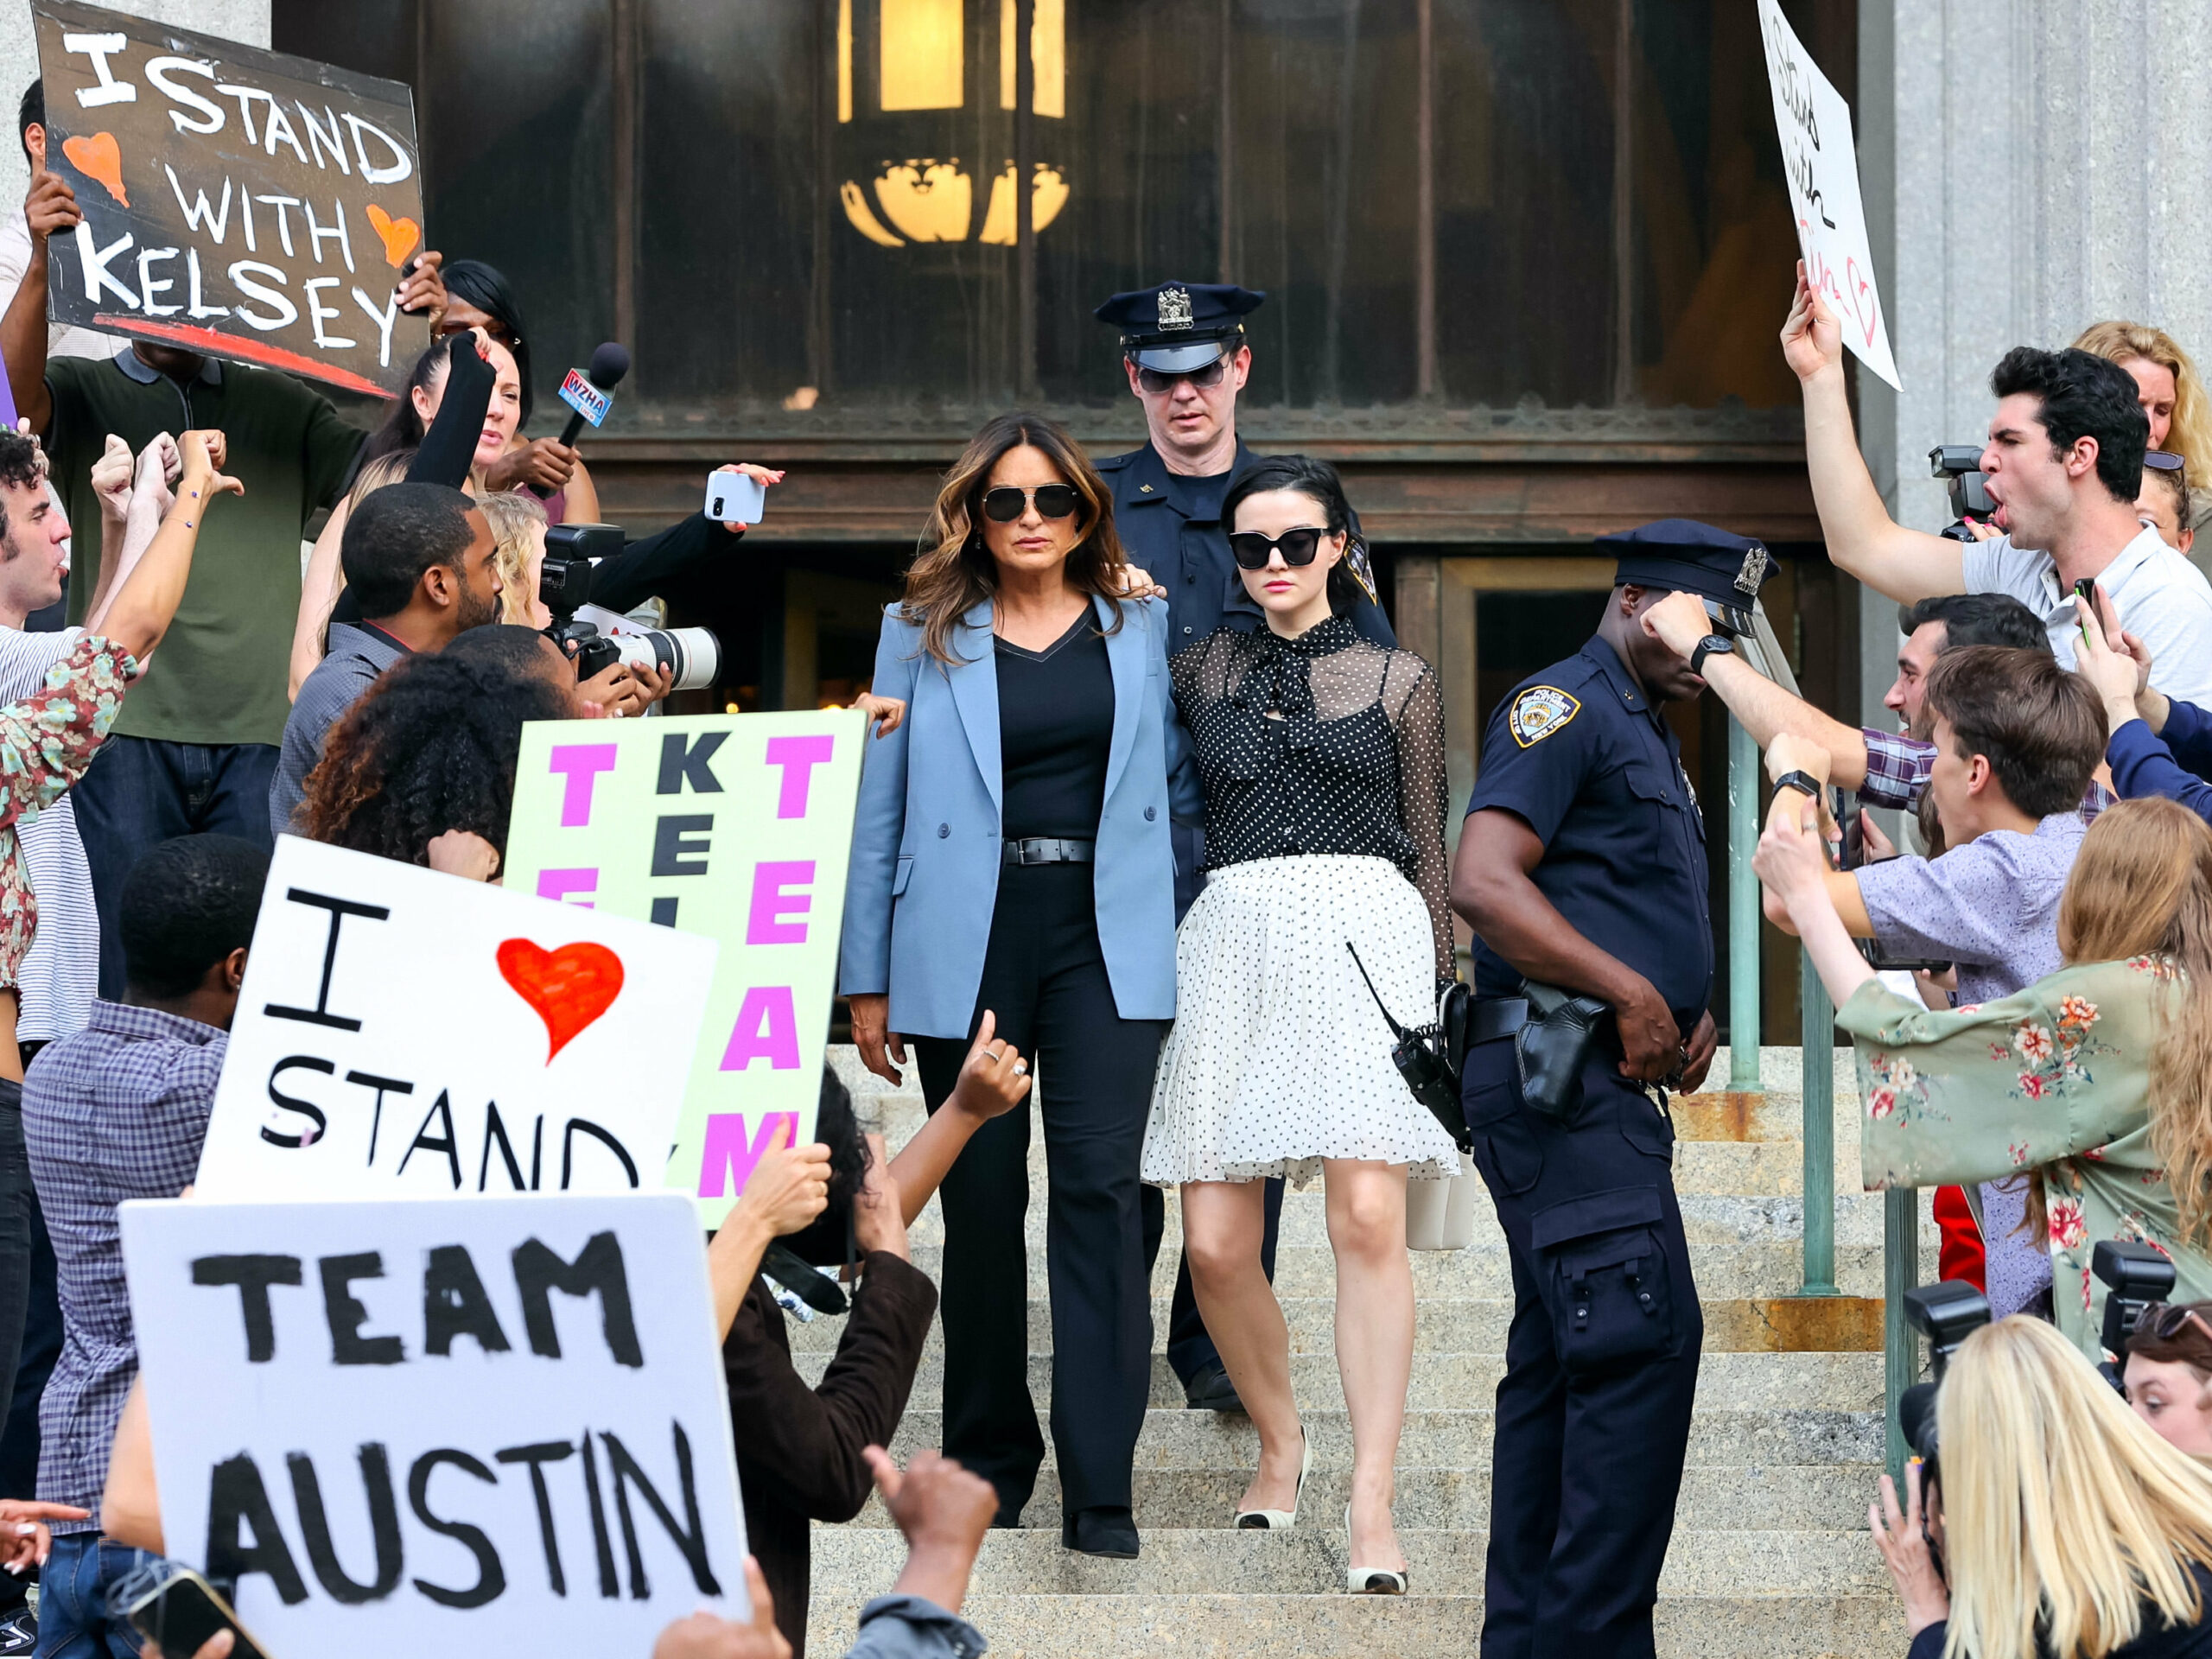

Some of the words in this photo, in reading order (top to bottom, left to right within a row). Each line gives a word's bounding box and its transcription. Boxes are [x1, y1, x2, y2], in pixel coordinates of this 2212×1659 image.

[62, 32, 137, 109] I
[144, 55, 413, 184] STAND
[164, 162, 355, 274] WITH
[74, 221, 398, 367] KELSEY
[569, 375, 604, 415] WZHA
[1519, 695, 1572, 712] DEPARTMENT
[1530, 728, 1548, 741] NEW
[1548, 715, 1567, 729] YORK
[1534, 689, 1565, 701] POLICE
[264, 887, 391, 1033] I
[698, 734, 835, 1198] TEAM
[260, 1054, 640, 1192] STAND
[189, 1229, 645, 1370] TEAM
[205, 1415, 723, 1610] AUSTIN
